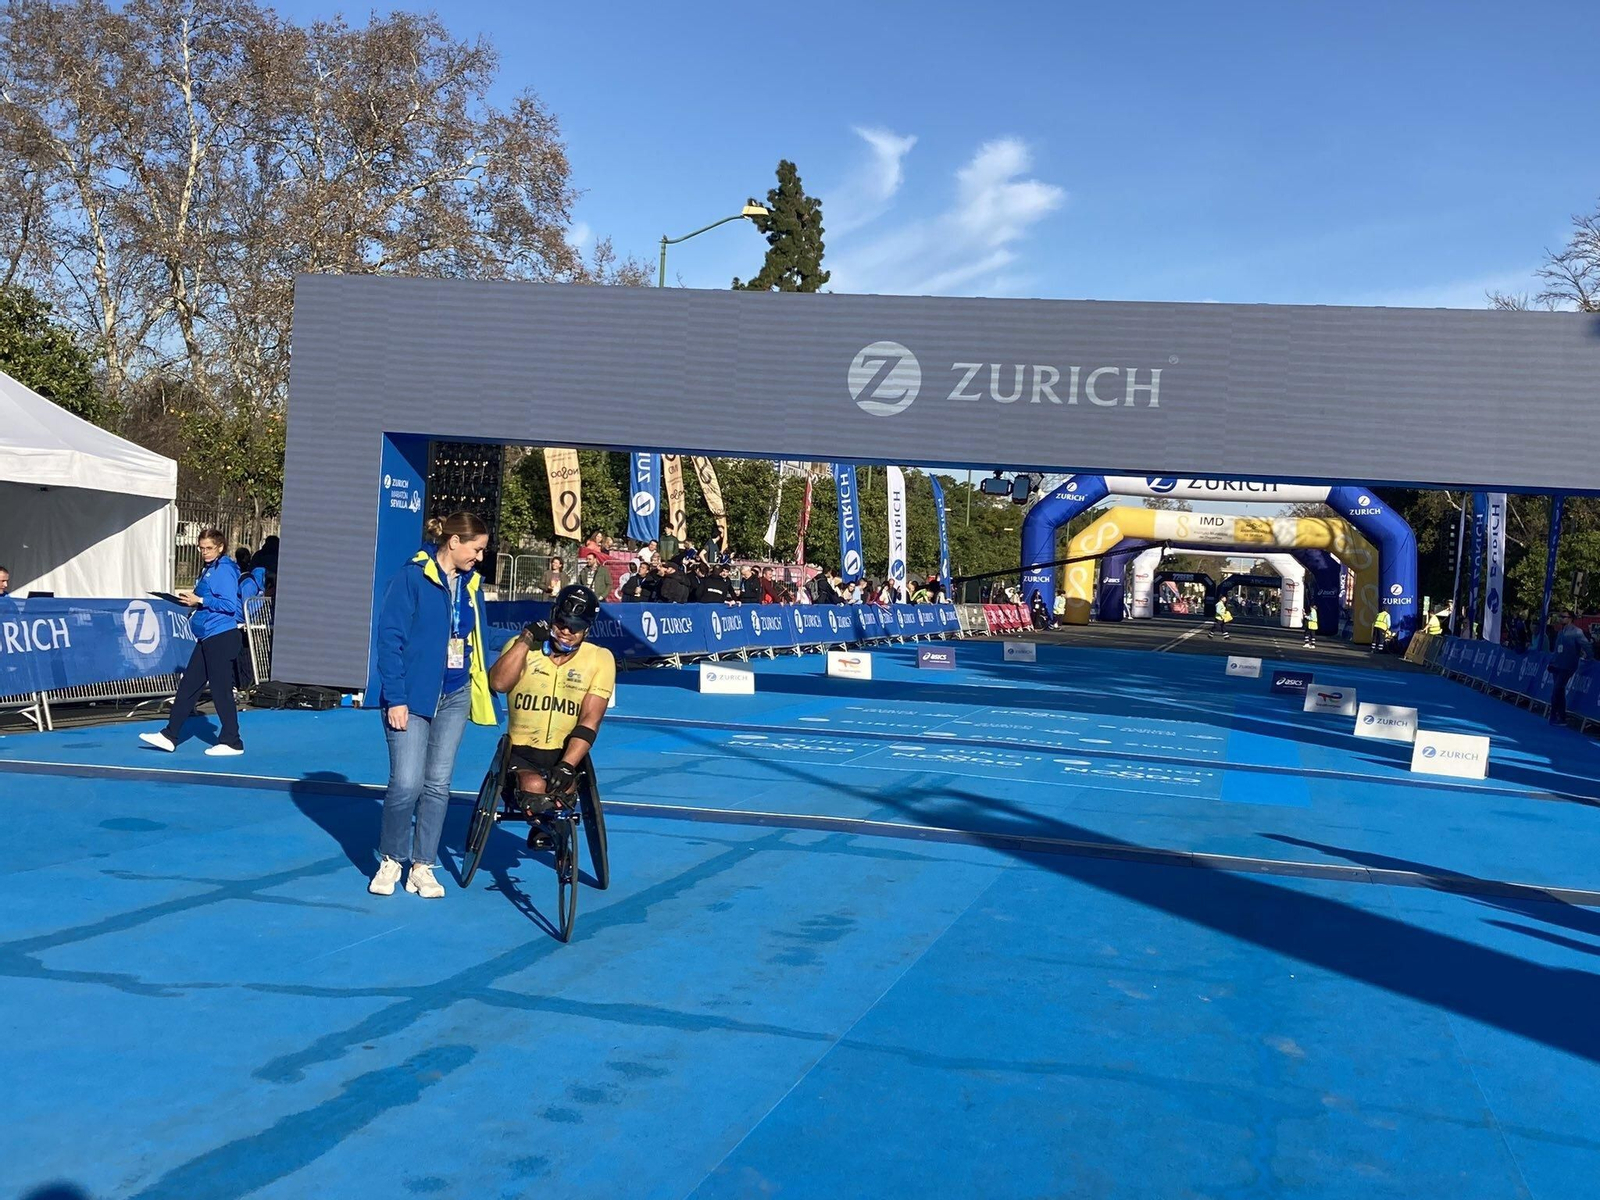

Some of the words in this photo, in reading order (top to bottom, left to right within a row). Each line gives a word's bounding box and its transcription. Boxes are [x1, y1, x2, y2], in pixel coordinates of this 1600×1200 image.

[947, 362, 1163, 408] ZURICH
[392, 478, 409, 489] ZURICH
[1055, 493, 1085, 502] ZURICH
[391, 499, 408, 509] SEVILLA
[1349, 508, 1381, 516] ZURICH
[1199, 516, 1225, 527] IMD
[1023, 575, 1050, 583] ZURICH
[1382, 597, 1412, 605] ZURICH
[722, 615, 743, 632] ZURICH
[0, 618, 71, 654] RICH
[719, 673, 748, 682] ZURICH
[514, 692, 580, 717] COLOMBI
[1376, 717, 1408, 727] ZURICH
[1440, 750, 1479, 761] ZURICH
